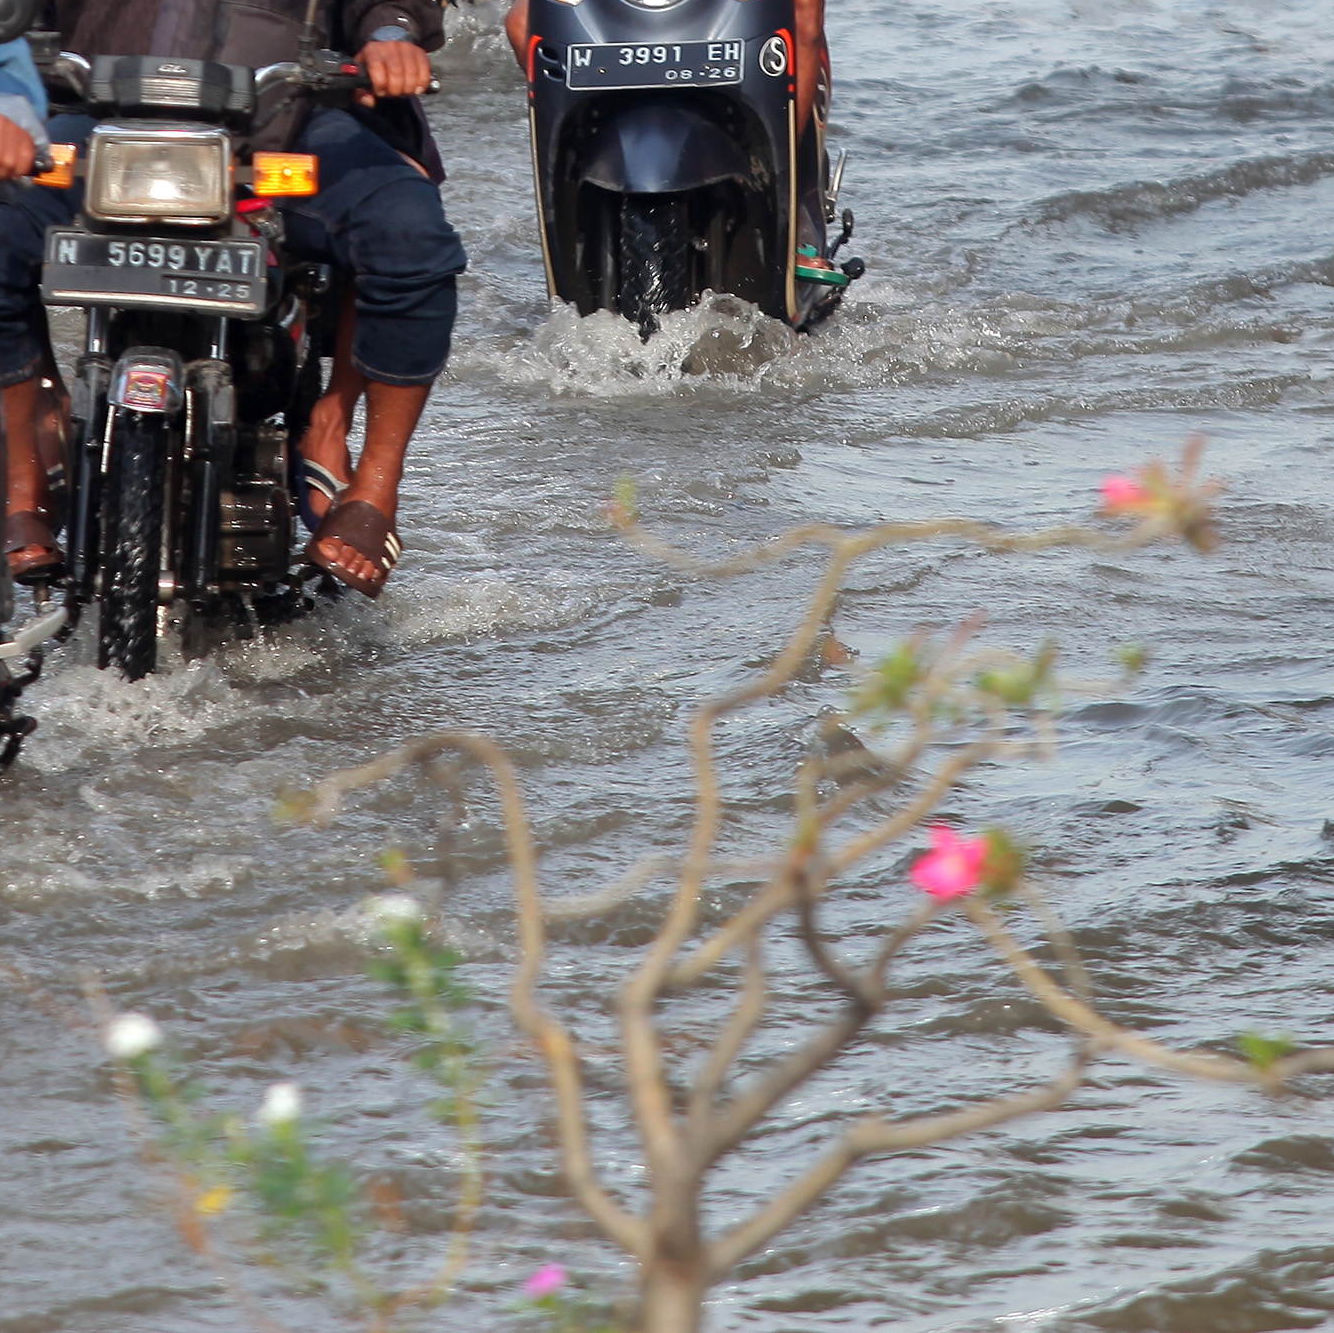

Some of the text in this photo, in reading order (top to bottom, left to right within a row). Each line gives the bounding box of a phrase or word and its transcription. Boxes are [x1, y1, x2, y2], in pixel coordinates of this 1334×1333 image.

[574, 42, 739, 67] W 3991 EH
[58, 239, 254, 275] N 5699 YAT
